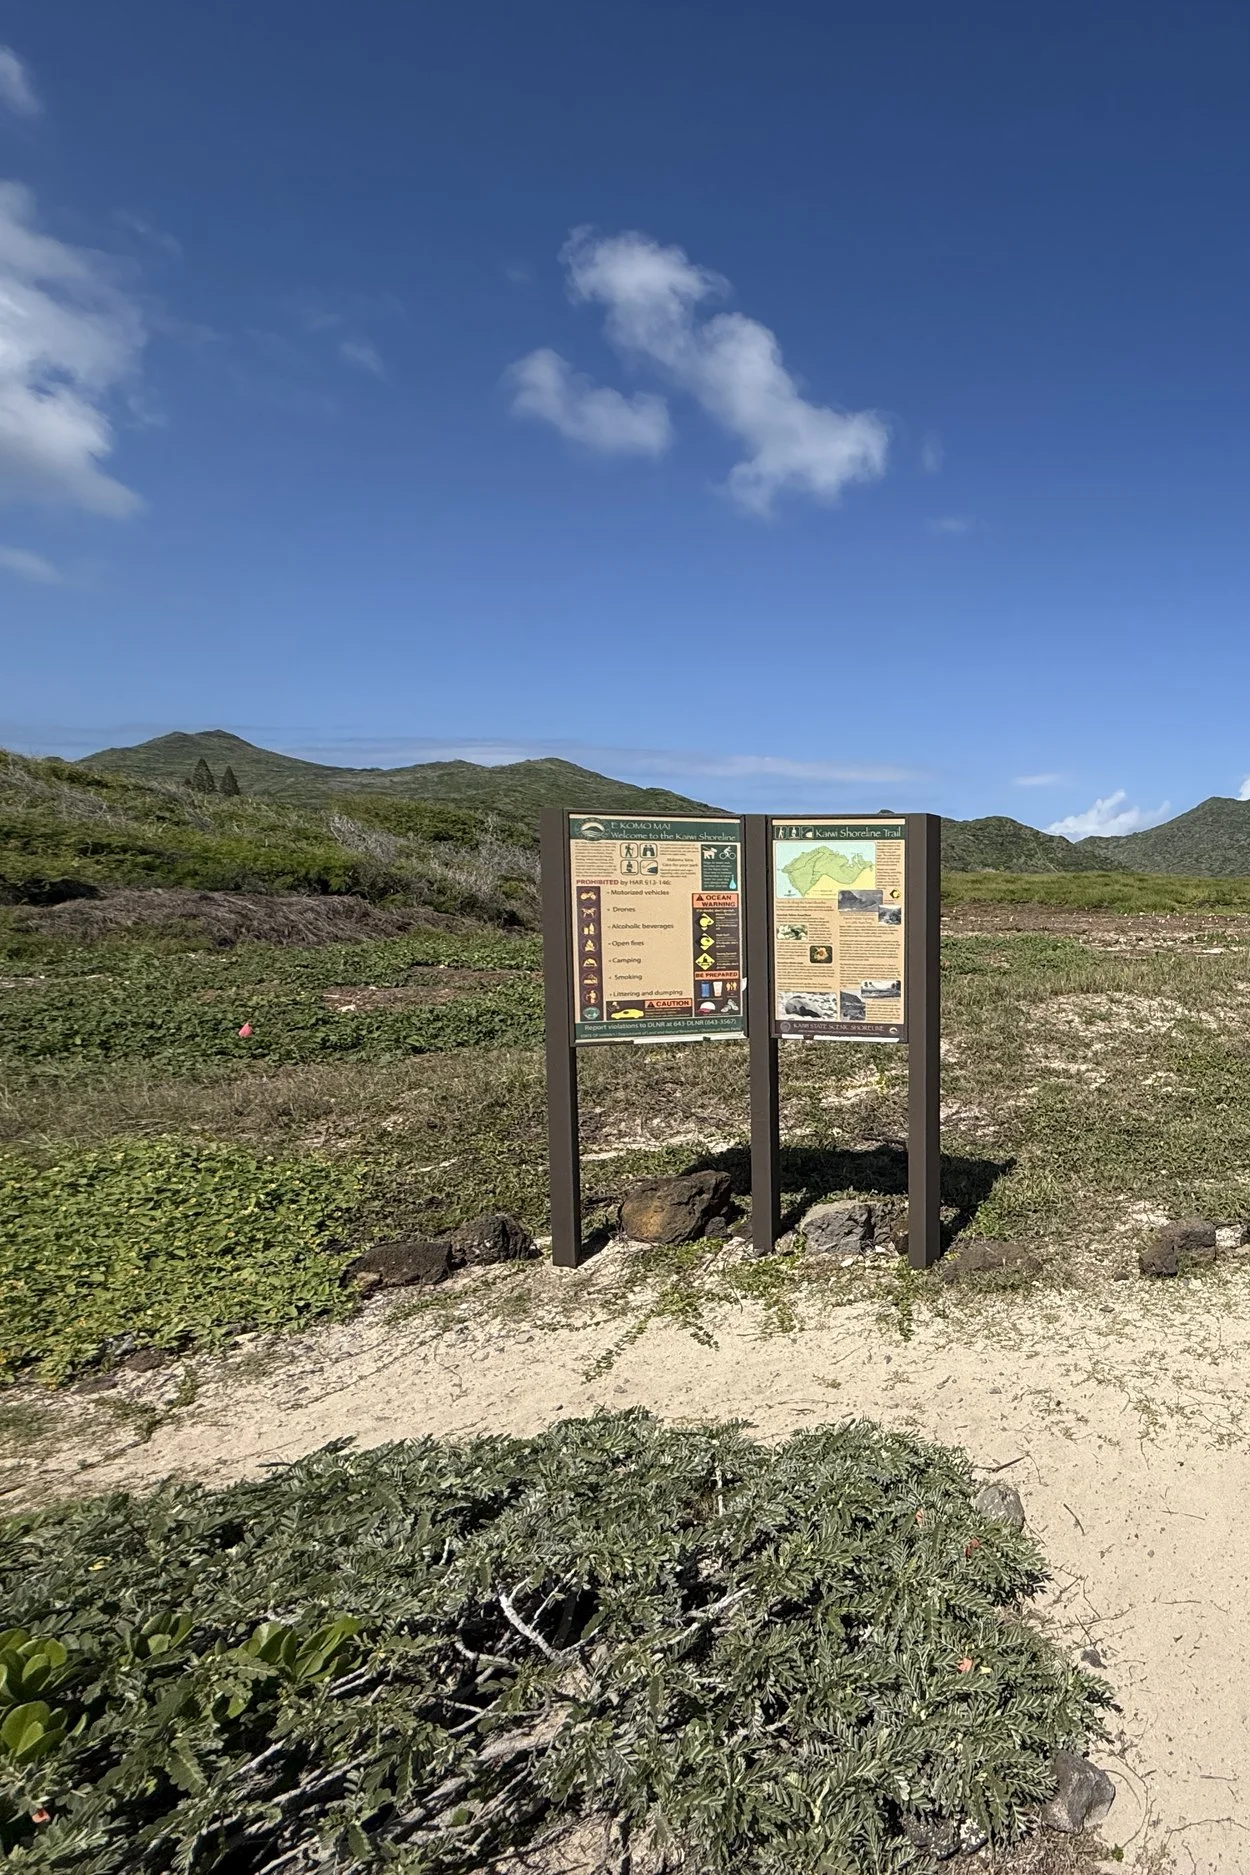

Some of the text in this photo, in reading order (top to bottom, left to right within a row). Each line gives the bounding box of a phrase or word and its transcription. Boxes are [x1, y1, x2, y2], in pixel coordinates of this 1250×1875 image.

[840, 827, 880, 837] Shoreline
[884, 827, 901, 836] Trail
[699, 833, 736, 841] Shoreline
